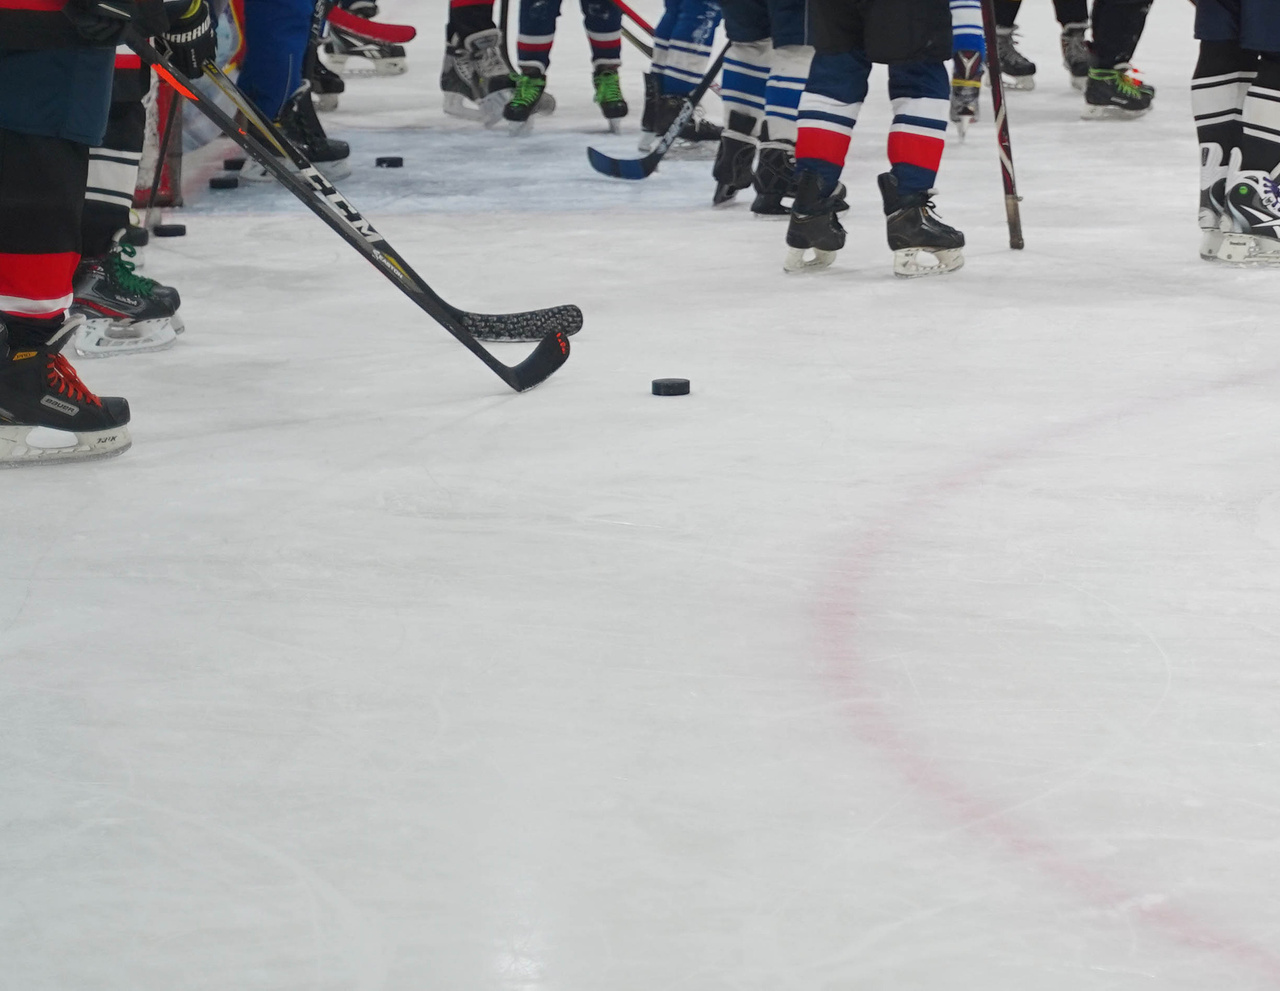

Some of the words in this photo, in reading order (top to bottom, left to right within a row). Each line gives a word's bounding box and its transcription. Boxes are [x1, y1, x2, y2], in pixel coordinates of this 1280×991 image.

[301, 163, 385, 244] CCM
[378, 252, 403, 279] EASTON
[44, 397, 75, 414] BAUER
